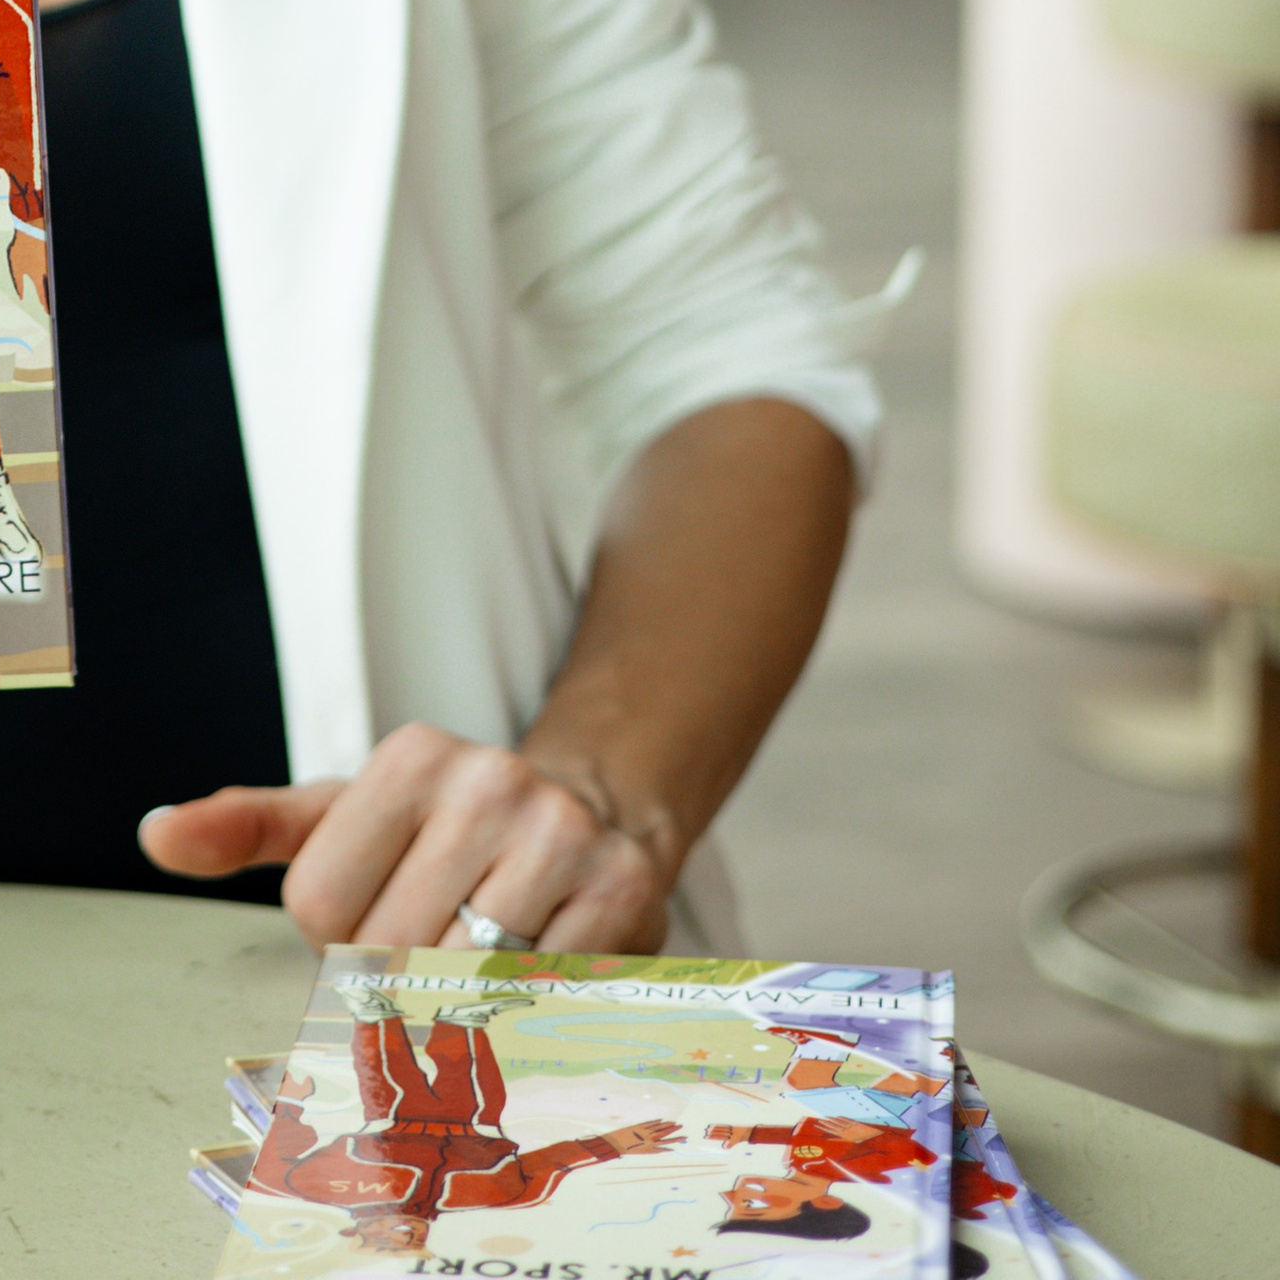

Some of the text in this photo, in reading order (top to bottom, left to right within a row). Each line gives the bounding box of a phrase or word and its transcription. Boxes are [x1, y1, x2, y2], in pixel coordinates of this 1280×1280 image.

[336, 973, 906, 1011] THE AMAZING ADVENTURE
[405, 1257, 586, 1280] SPORT
